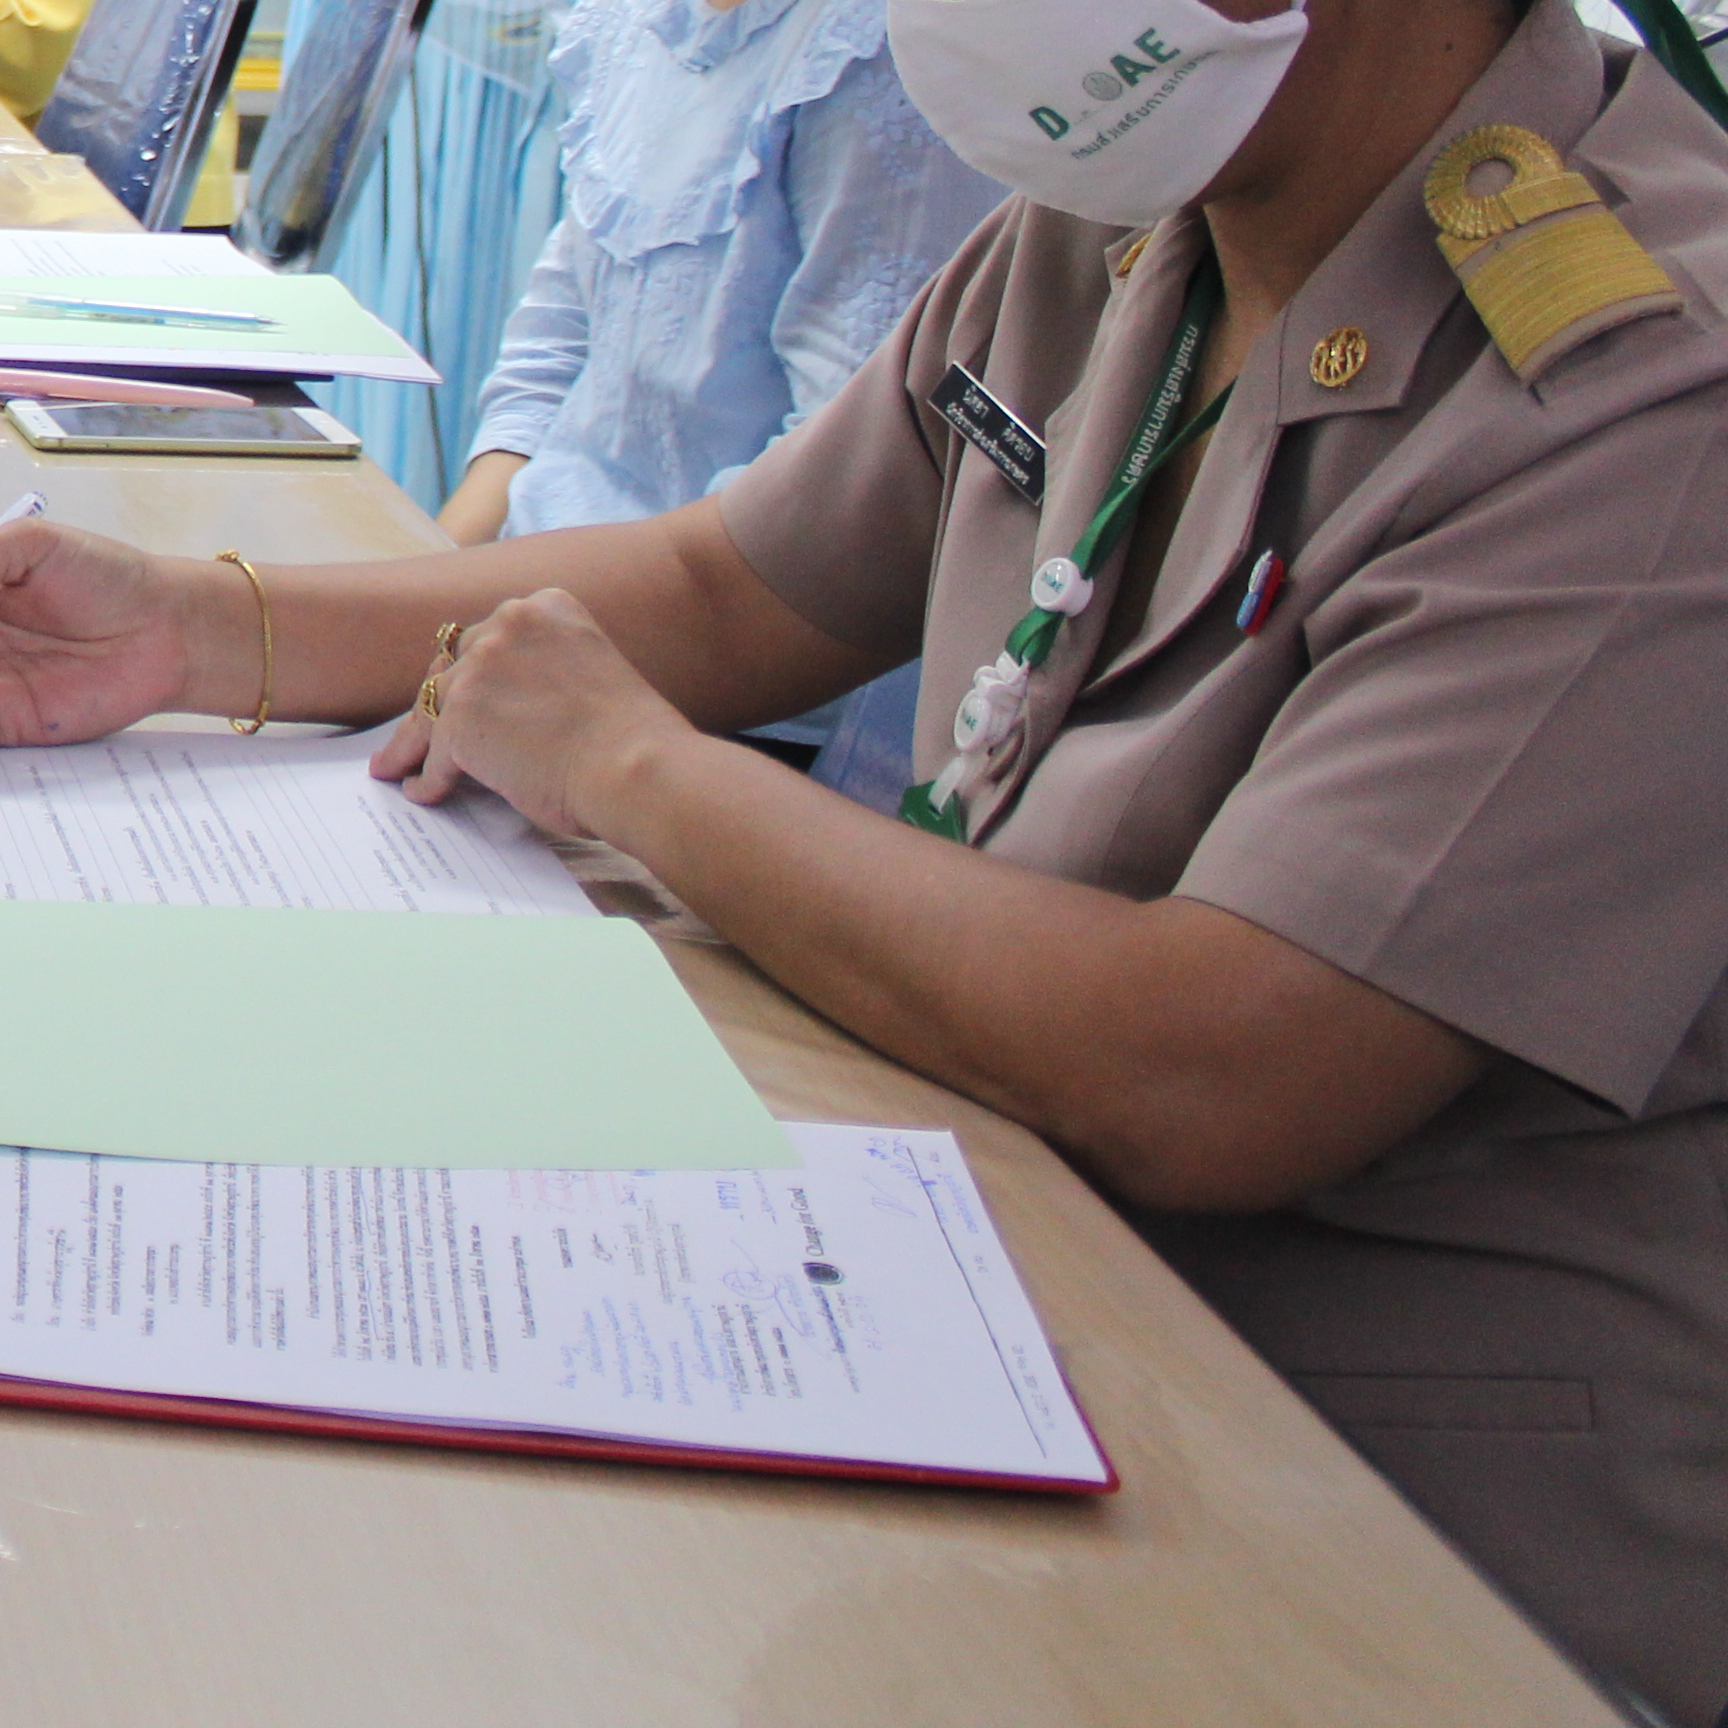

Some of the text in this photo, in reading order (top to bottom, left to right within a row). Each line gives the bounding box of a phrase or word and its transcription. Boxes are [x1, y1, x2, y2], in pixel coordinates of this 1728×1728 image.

[1120, 324, 1199, 485] กรมส่งเสริมการเกษตร
